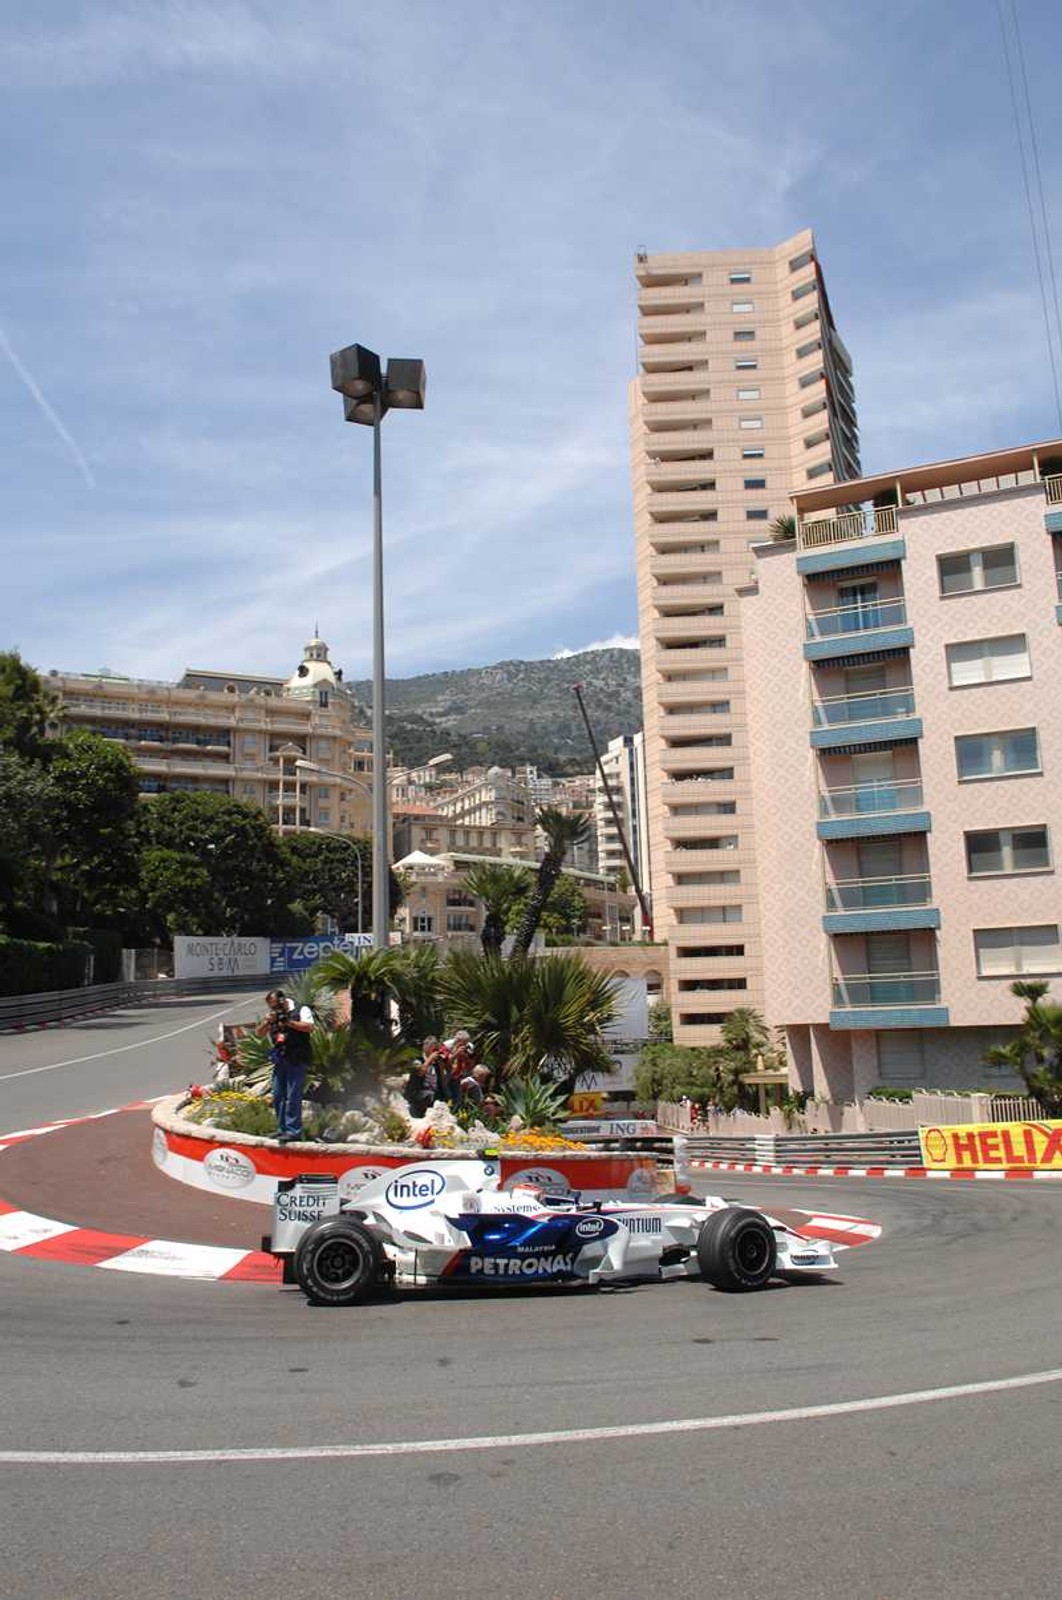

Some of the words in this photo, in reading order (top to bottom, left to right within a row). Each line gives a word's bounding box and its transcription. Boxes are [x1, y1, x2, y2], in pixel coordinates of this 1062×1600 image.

[609, 1122, 637, 1136] ING
[393, 1178, 436, 1199] intel
[277, 1193, 327, 1208] CREDIT
[469, 1253, 576, 1275] PETRONAS
